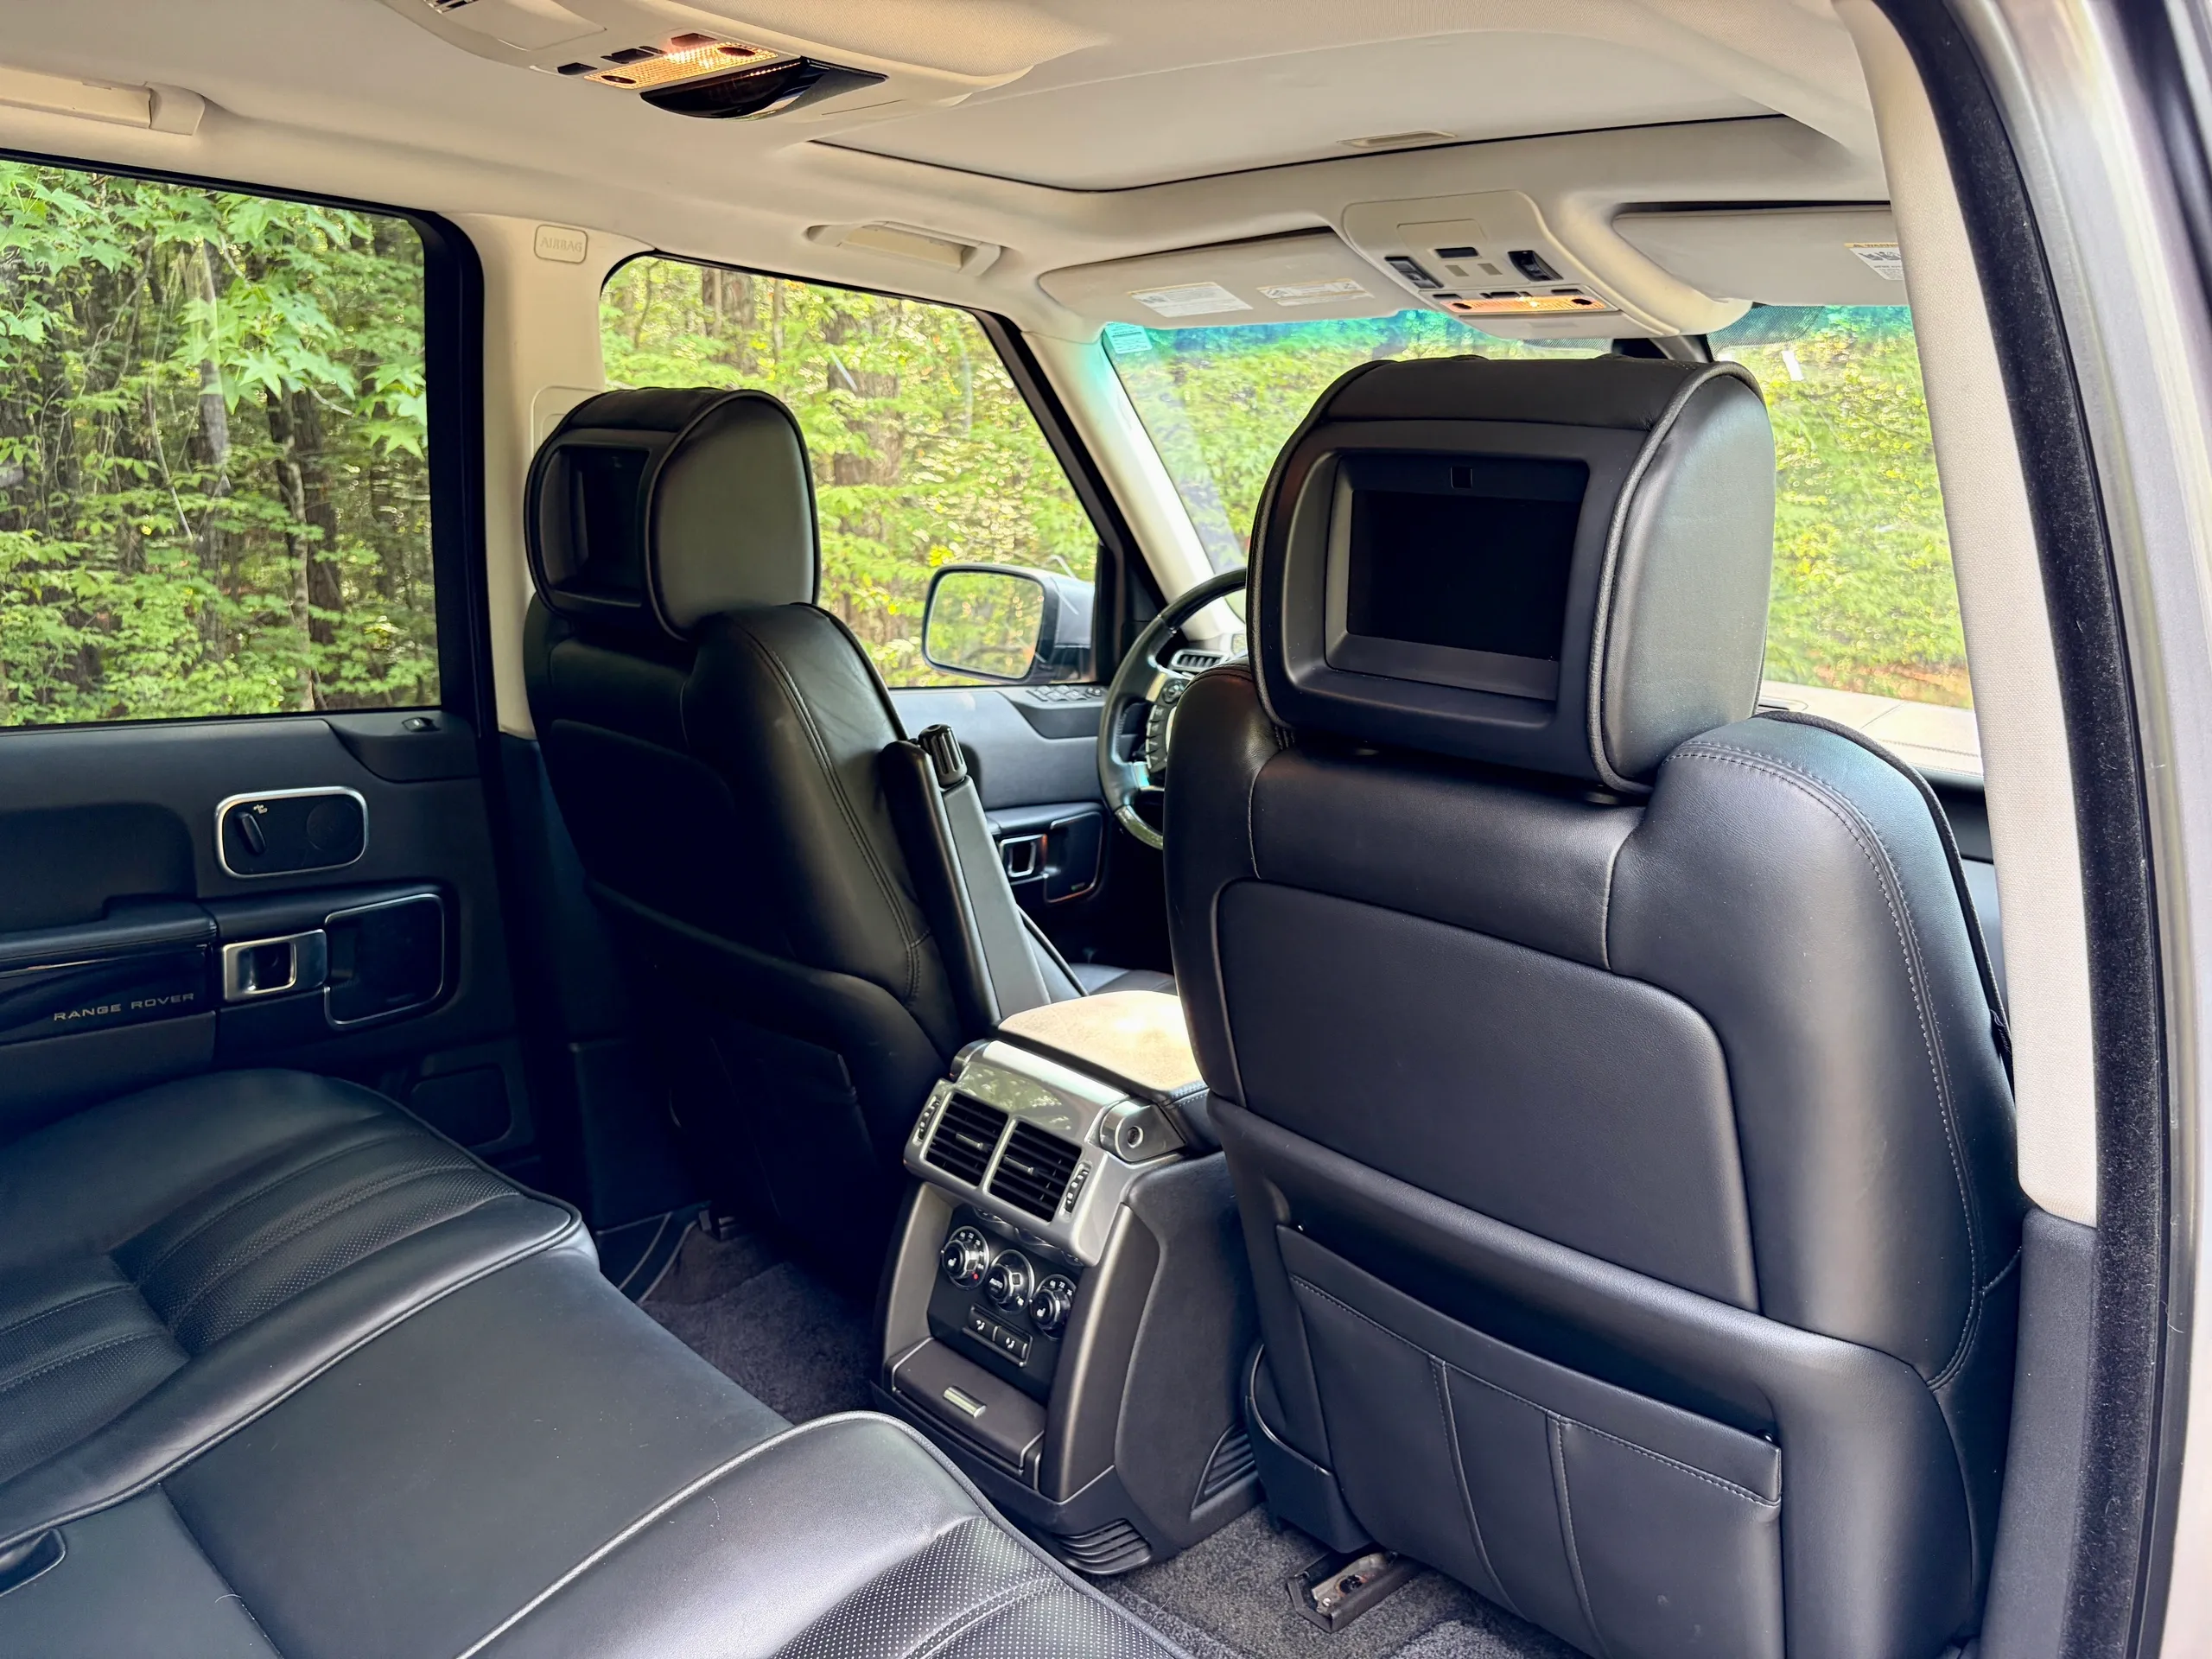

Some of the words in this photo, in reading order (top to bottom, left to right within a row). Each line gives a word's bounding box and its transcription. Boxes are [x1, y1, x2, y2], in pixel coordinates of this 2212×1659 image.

[540, 237, 582, 252] AIRBAG
[54, 1003, 122, 1021] RANGE
[130, 993, 194, 1010] ROVER
